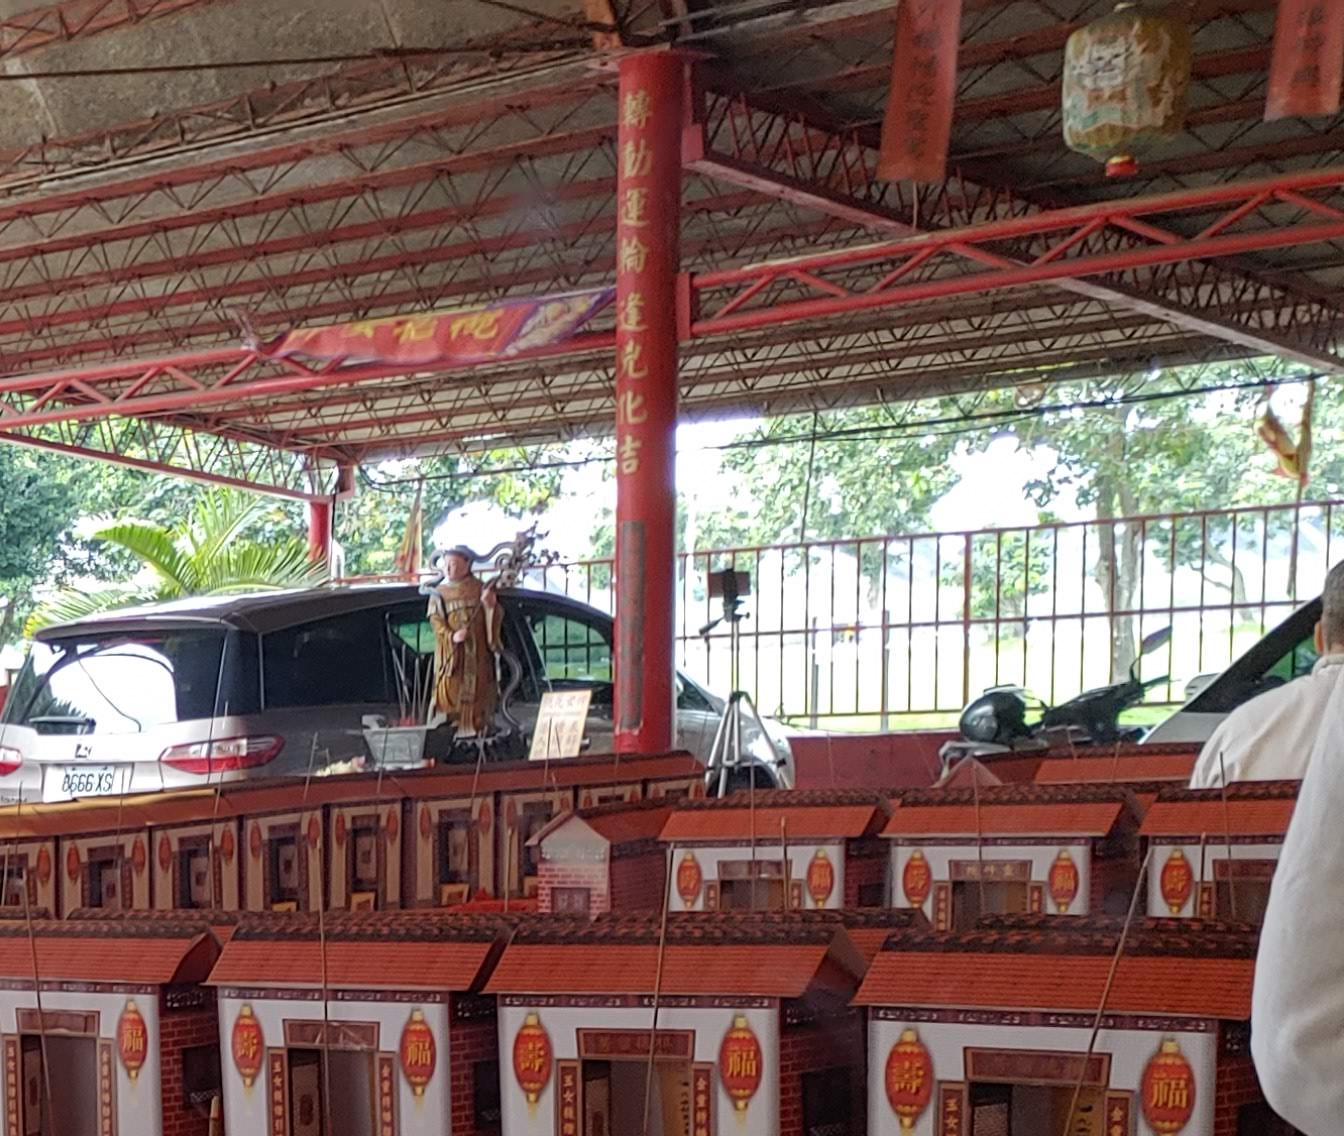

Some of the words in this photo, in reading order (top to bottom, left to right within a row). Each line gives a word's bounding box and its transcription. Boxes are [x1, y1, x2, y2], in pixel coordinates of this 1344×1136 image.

[123, 1028, 143, 1053] 福
[407, 1039, 432, 1066] 福
[727, 1047, 757, 1078] 福
[1150, 1074, 1187, 1109] 福
